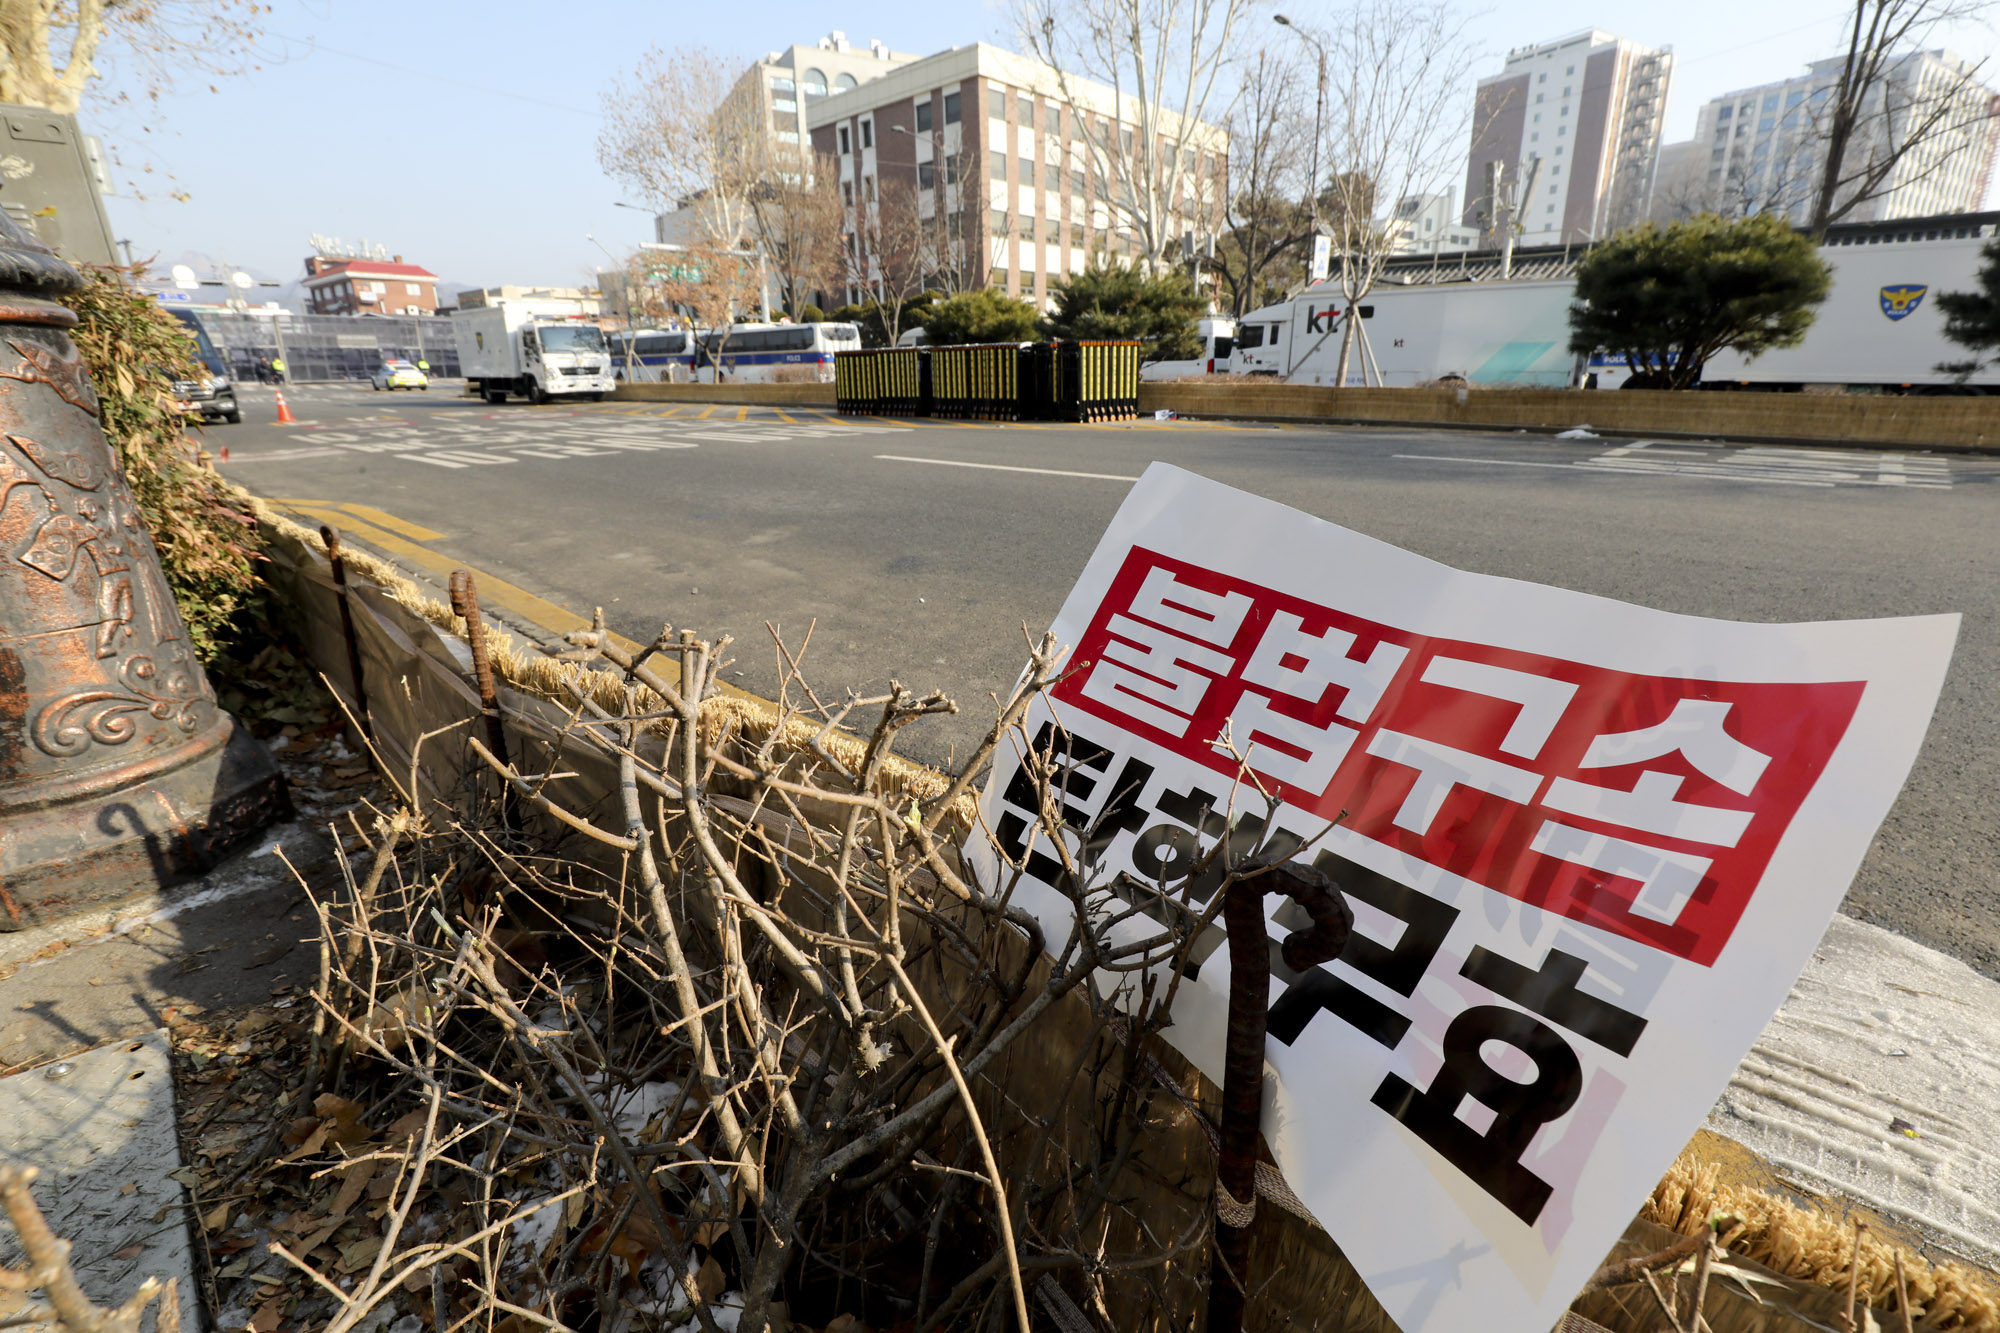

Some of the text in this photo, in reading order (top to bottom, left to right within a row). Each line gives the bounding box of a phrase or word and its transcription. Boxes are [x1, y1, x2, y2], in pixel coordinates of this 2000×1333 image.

[1307, 303, 1341, 334] kt
[1393, 338, 1406, 348] kt
[1242, 354, 1255, 365] kt
[1081, 564, 1773, 927] 불법구속
[997, 720, 1648, 1227] 탄핵무효
